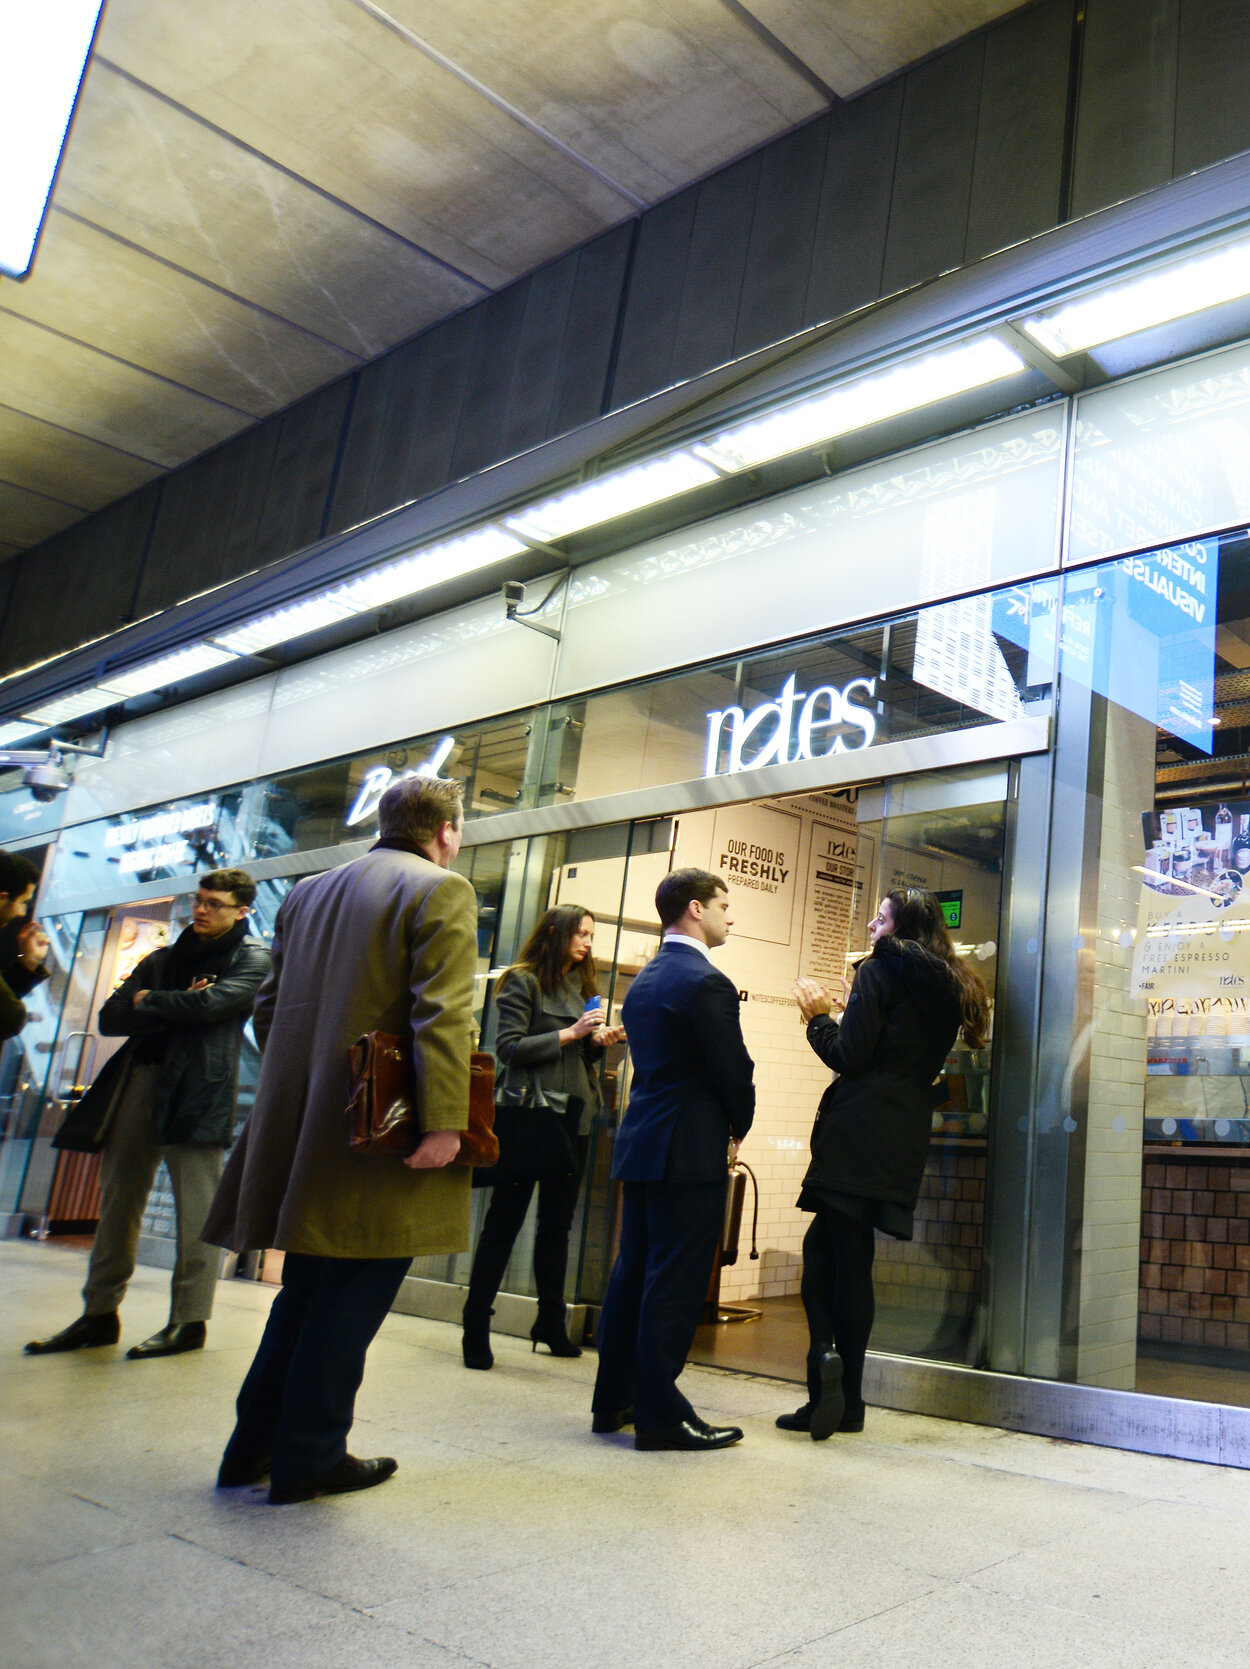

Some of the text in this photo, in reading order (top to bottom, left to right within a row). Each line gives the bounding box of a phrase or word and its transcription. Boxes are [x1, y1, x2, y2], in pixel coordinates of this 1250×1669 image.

[704, 672, 877, 779] notes
[727, 839, 785, 867] OUR FOOD IS
[720, 854, 790, 883] FRESHLY
[839, 864, 855, 878] STOR
[727, 873, 779, 895] PREPARED DAILY
[1148, 911, 1169, 919] BUY
[1157, 941, 1192, 952] ENJOY
[1142, 952, 1230, 963] FREE ESPRESSO
[1141, 965, 1190, 975] MARTINI
